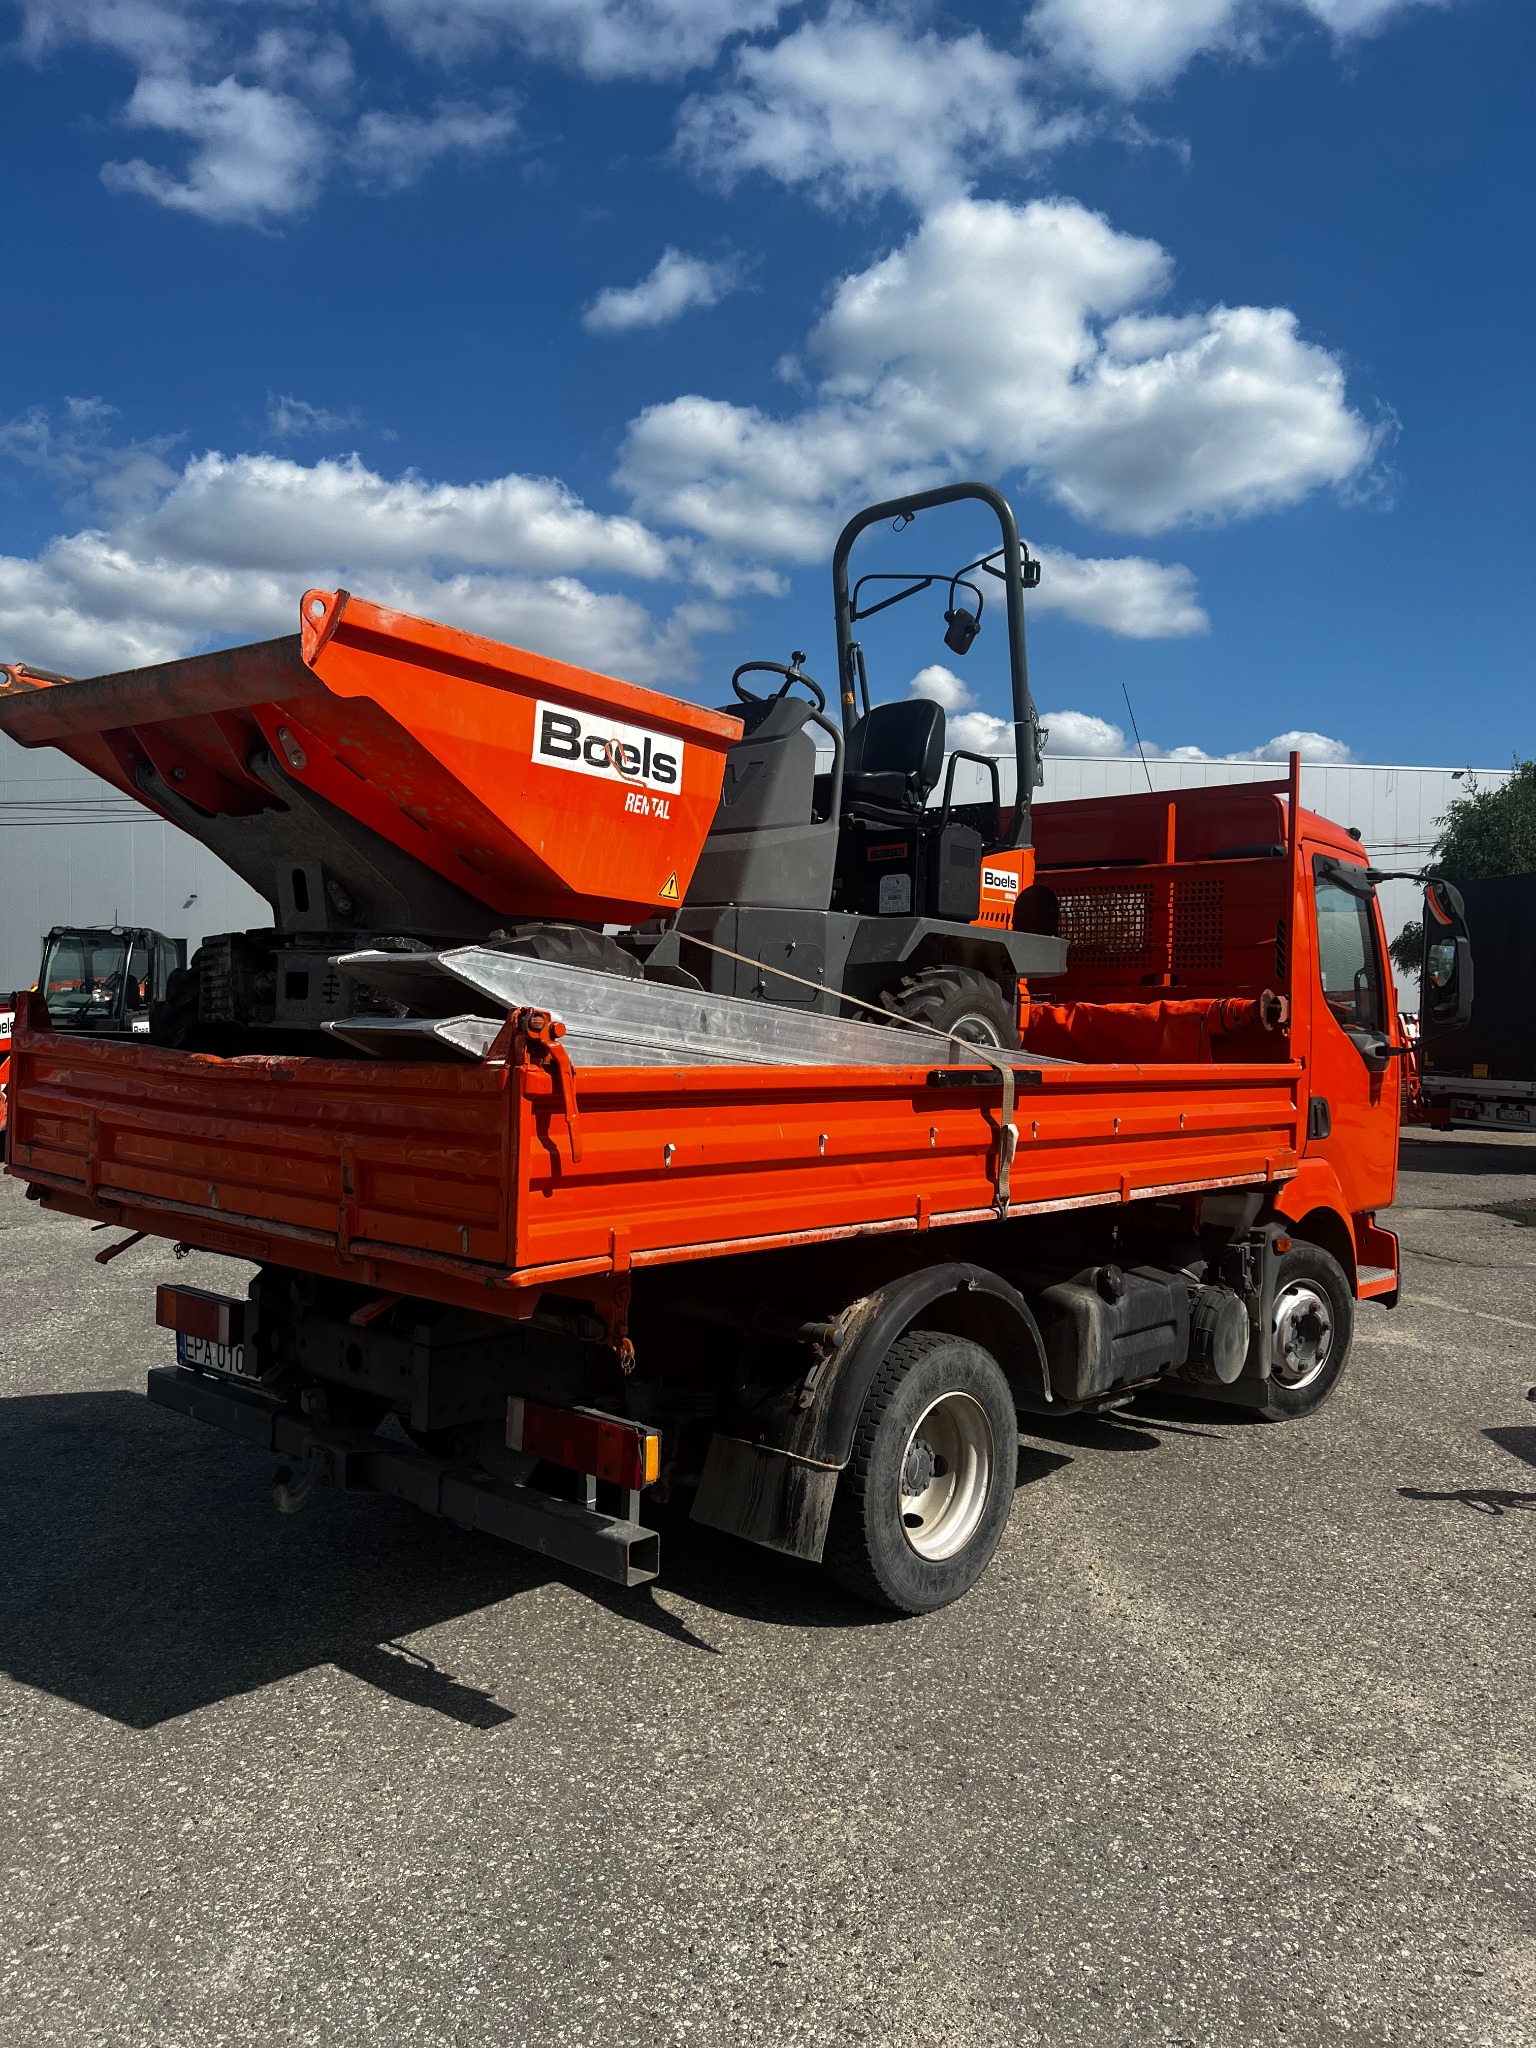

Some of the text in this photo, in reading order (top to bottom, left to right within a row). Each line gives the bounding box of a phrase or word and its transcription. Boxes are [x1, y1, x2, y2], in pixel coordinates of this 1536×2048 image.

[540, 709, 677, 784] Boels
[624, 792, 670, 820] RENTAL
[984, 871, 1017, 889] Boels
[0, 1017, 15, 1034] els
[186, 1334, 213, 1365] EPA
